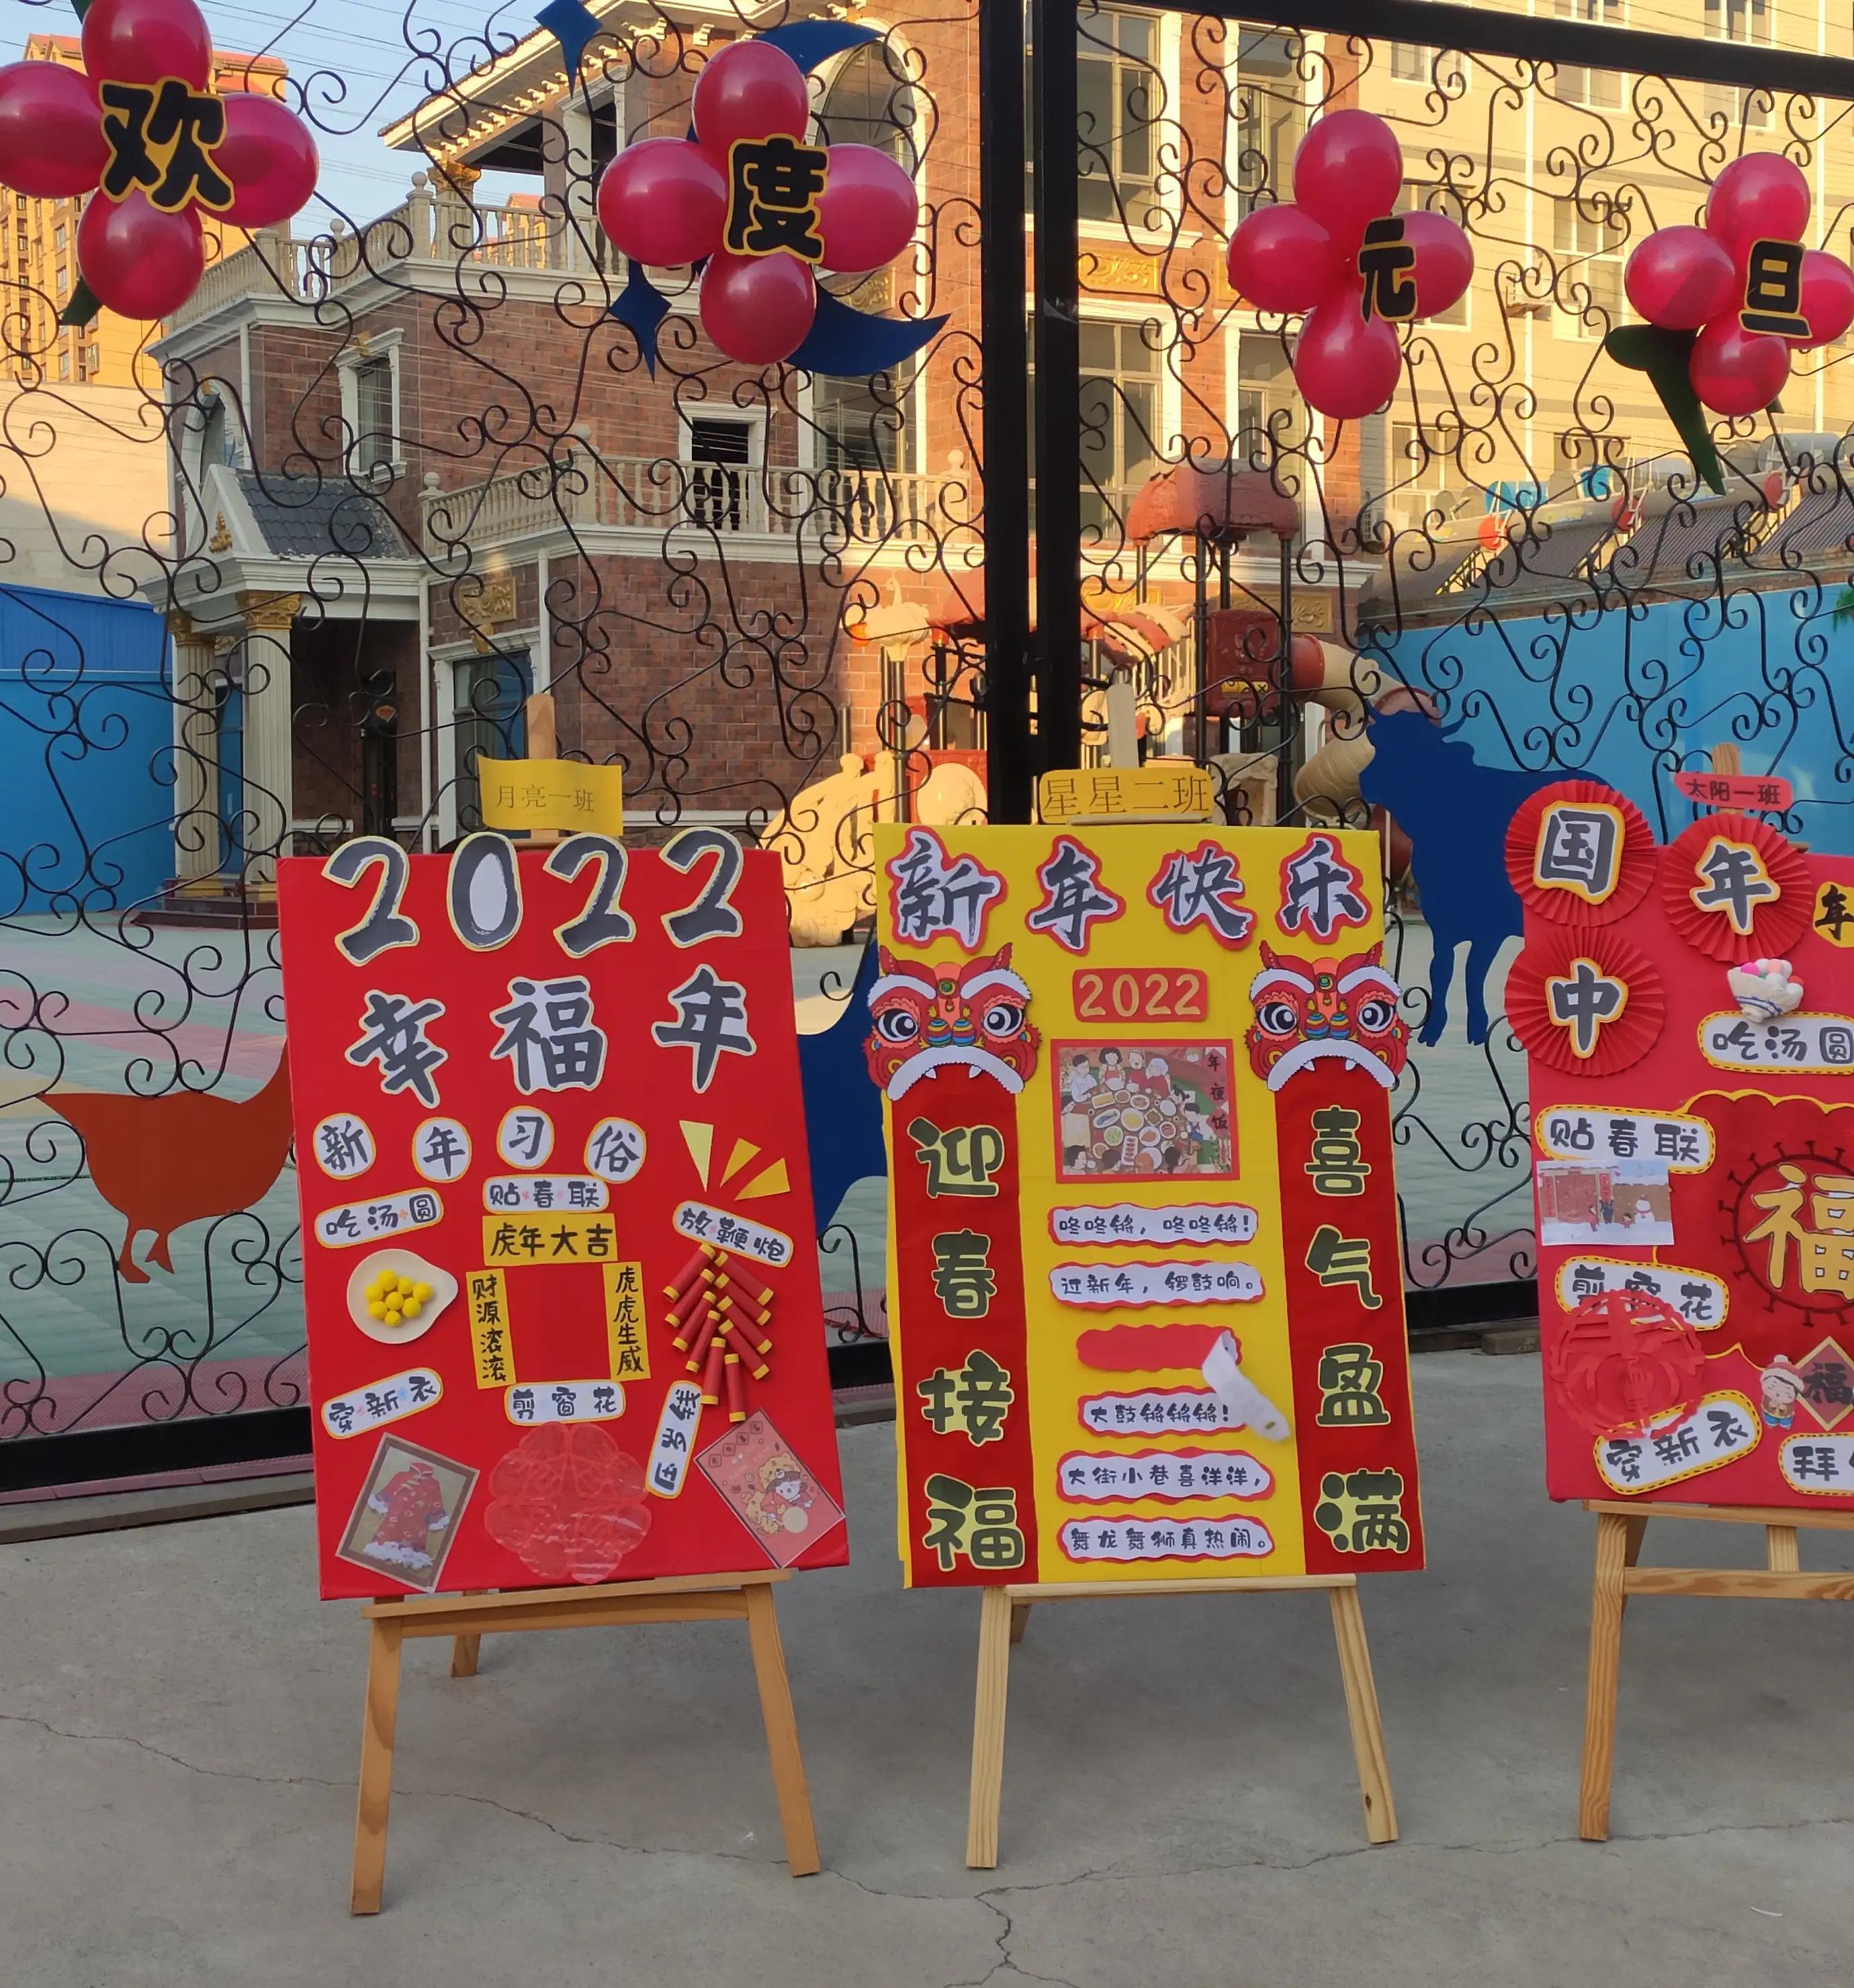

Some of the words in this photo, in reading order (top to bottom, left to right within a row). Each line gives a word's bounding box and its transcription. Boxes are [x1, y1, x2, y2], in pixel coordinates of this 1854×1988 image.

[101, 79, 234, 211] 欢
[726, 136, 827, 262] 度
[1359, 218, 1417, 323] 元
[1740, 239, 1812, 337] 旦
[496, 784, 594, 811] 月亮一班
[1045, 775, 1208, 816] 星星二班
[1687, 778, 1780, 805] 太阳一班
[1540, 809, 1615, 894] 国
[1697, 844, 1772, 930] 年
[324, 829, 742, 964] 2022
[893, 834, 1365, 950] 新年快乐
[1079, 973, 1201, 1016] 2022
[1552, 964, 1620, 1051] 中
[348, 966, 755, 1108] 幸福年
[1713, 1022, 1854, 1065] 吃汤圆
[1207, 1054, 1228, 1130] 年夜饭
[320, 1115, 640, 1177] 新年习俗
[1550, 1118, 1700, 1163] 贴春联
[326, 1194, 437, 1237] 吃汤圆
[490, 1180, 600, 1208] 贴春联
[1745, 1163, 1854, 1301] 福
[491, 1222, 613, 1257] 虎年大吉
[680, 1208, 785, 1263] 放鞭炮
[472, 1273, 506, 1382] 财源滚滚
[613, 1267, 644, 1375] 虎虎生威
[908, 1117, 1025, 1572] 迎春接福
[1304, 1105, 1410, 1554] 喜气盈满
[329, 1375, 437, 1434] 穿新衣
[513, 1385, 617, 1418] 剪窗花
[654, 1389, 701, 1491] 压岁钱
[1606, 1410, 1749, 1482] 穿新衣
[1793, 1445, 1854, 1482] 拜
